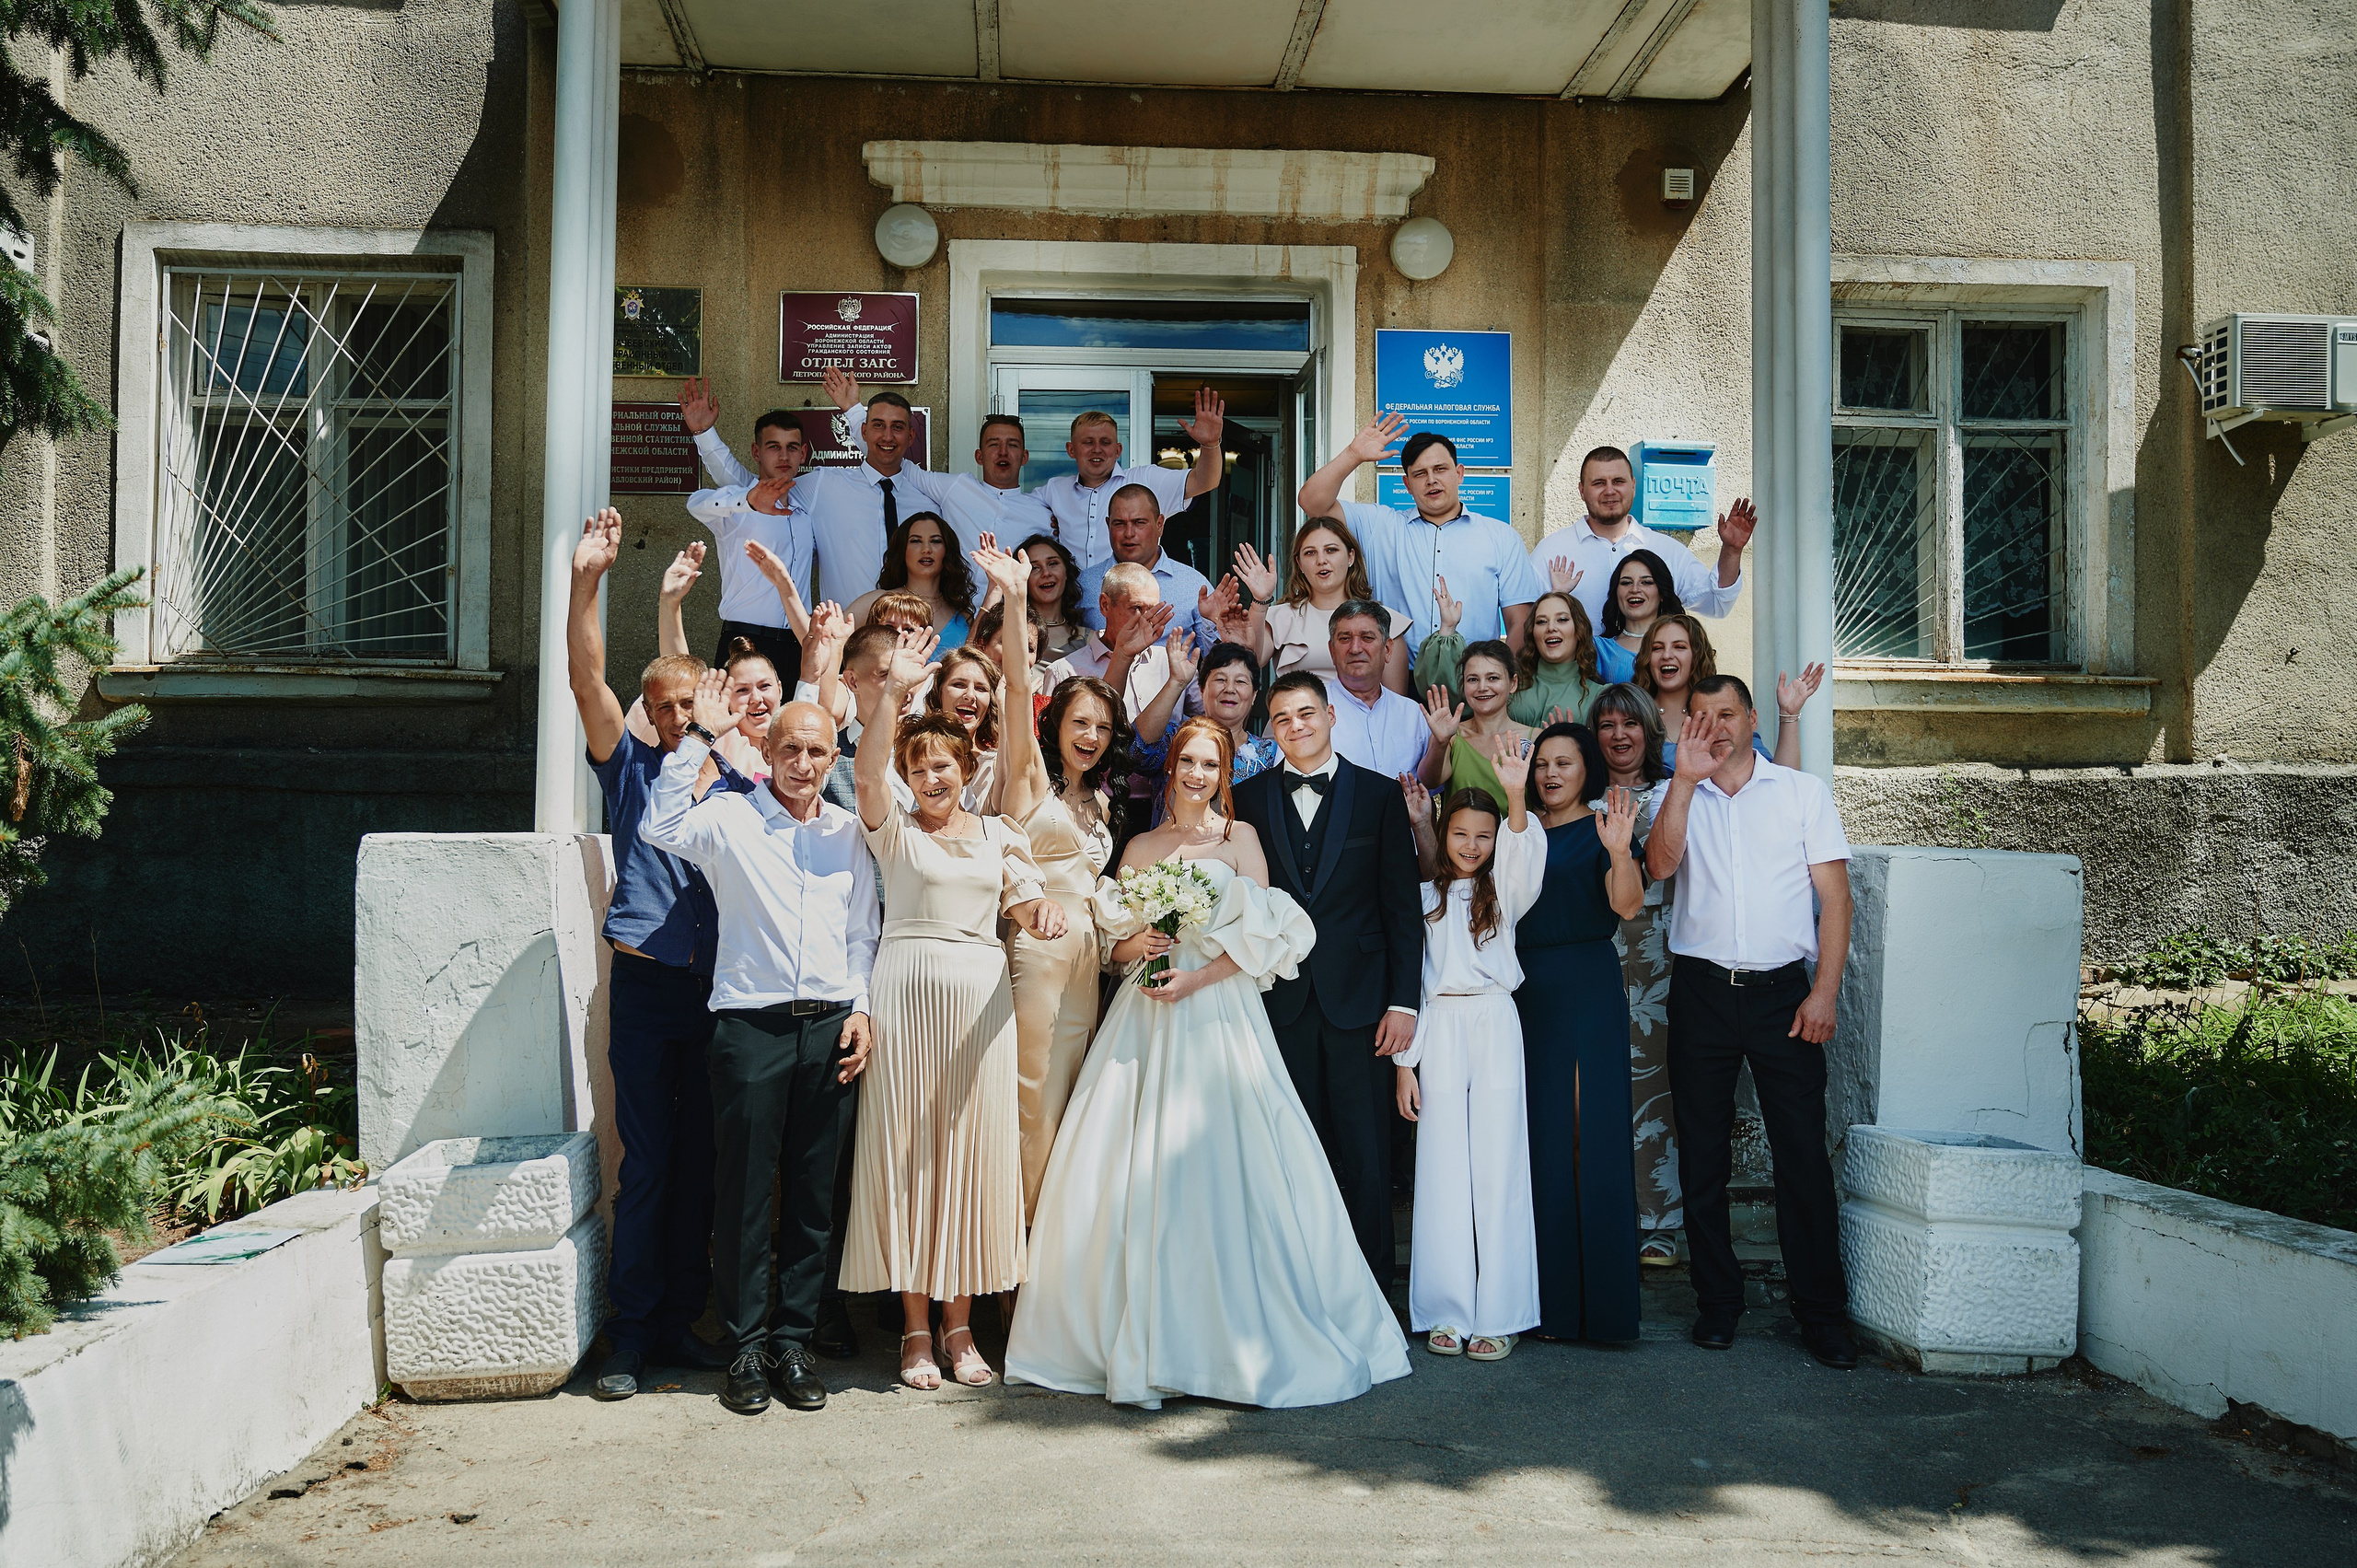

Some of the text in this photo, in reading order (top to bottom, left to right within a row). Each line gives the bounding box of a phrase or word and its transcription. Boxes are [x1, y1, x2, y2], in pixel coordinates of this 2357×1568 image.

[801, 357, 898, 369] ОТДЕЛ ЗАГС
[874, 370, 905, 378] РАЙОНА
[1385, 402, 1432, 411] ФЕДЕРАЛЬНАЯ
[612, 411, 659, 420] РИАЛЬНЫЙ
[644, 424, 680, 432] СЛУЖБЫ
[811, 449, 867, 460] АДМИНИСТР
[641, 466, 693, 474] ПРЕДПРИЯТИЙ
[611, 475, 682, 484] АВЛОВСКИЙ РАЙОН)
[1646, 475, 1710, 494] ПОЧТА
